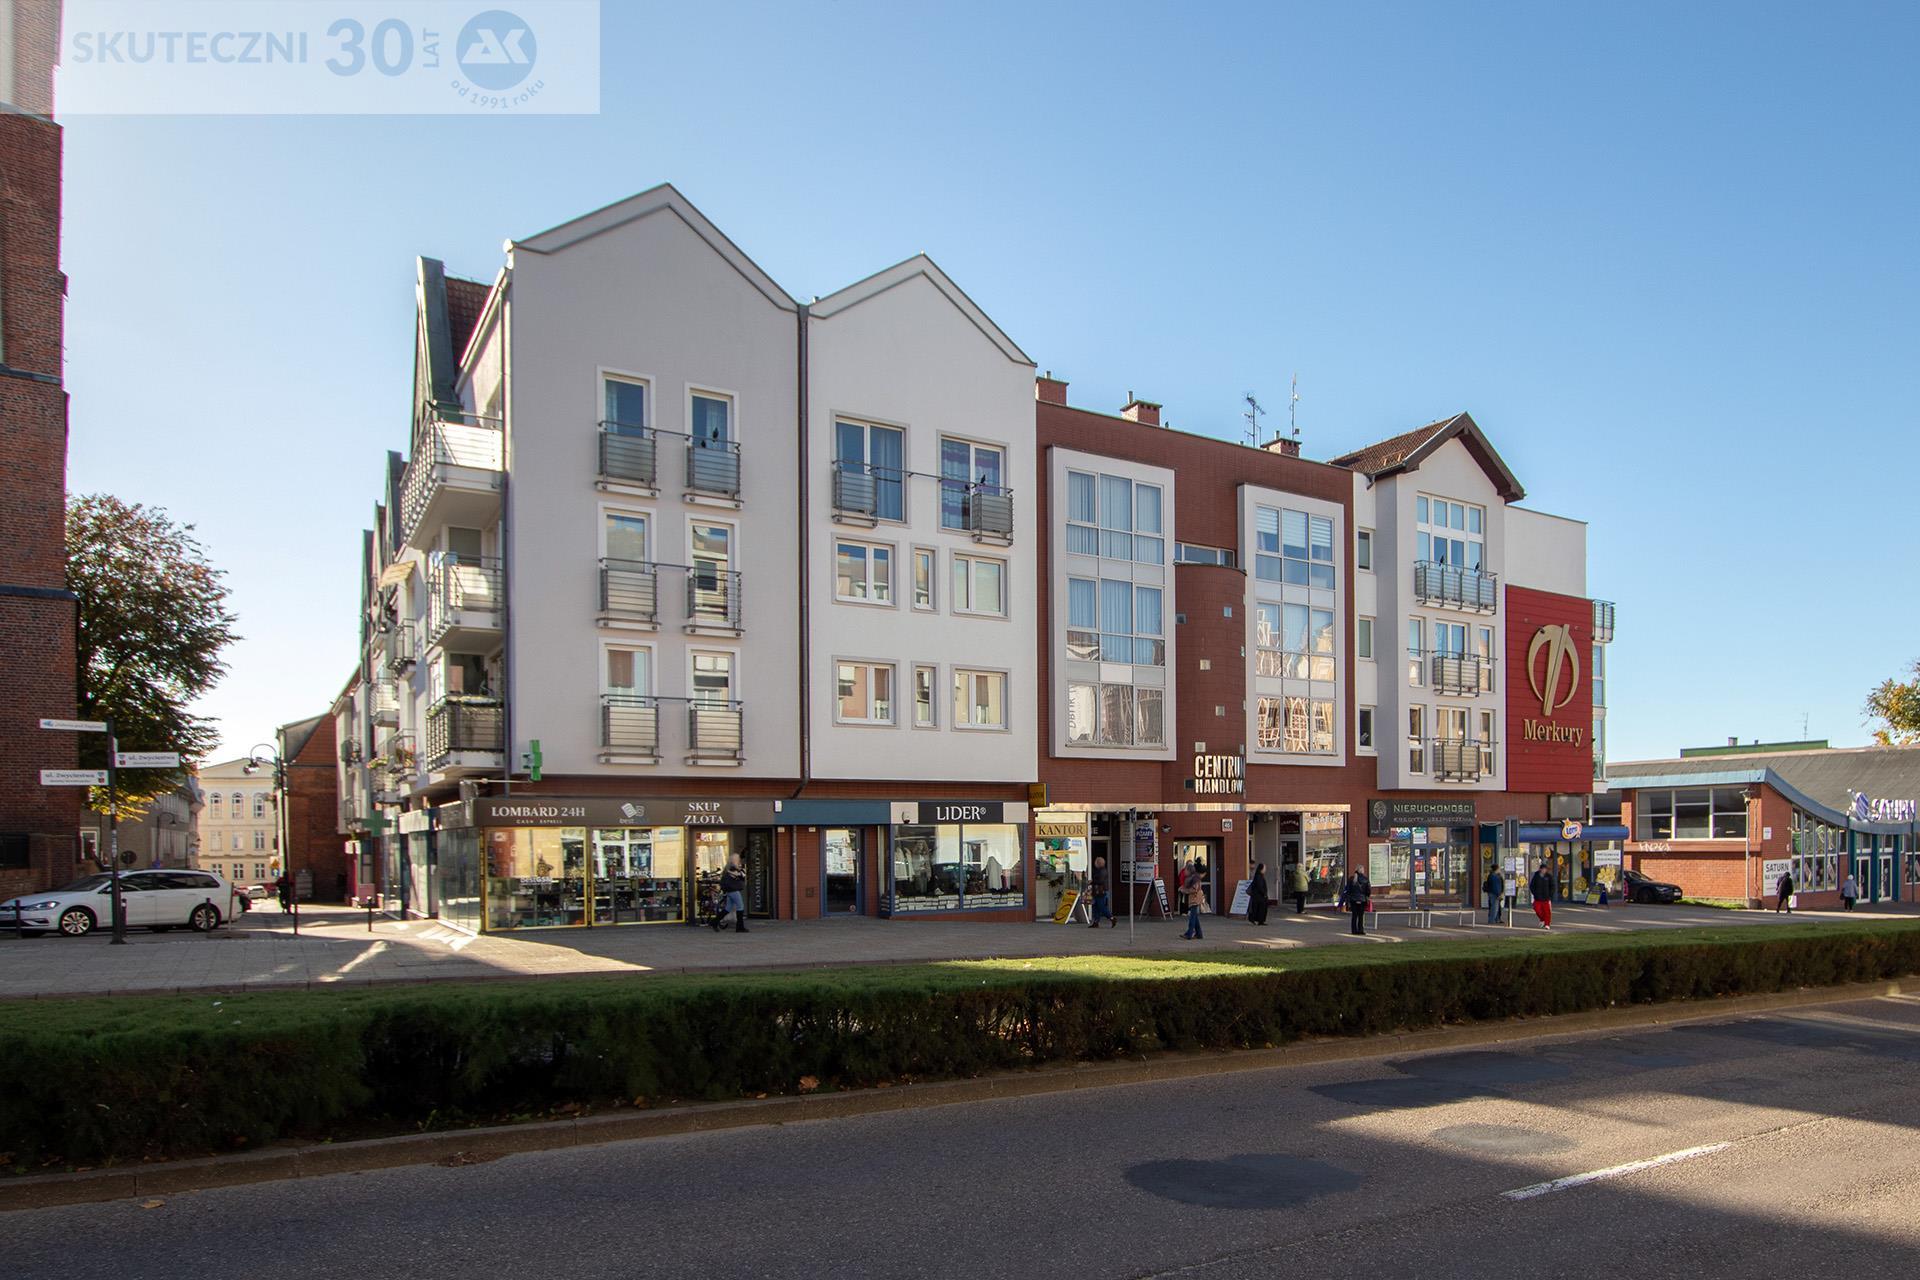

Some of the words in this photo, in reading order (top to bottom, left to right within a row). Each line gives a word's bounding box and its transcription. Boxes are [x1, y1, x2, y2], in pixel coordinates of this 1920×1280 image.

[1523, 718, 1584, 748] Merkury
[1195, 779, 1244, 794] HANDLOW
[688, 802, 720, 811] SKUP
[1393, 803, 1473, 813] NIERUCHOMOŚCI
[1871, 798, 1917, 821] SATURN
[492, 807, 558, 817] LOMBARD
[561, 807, 586, 817] 24H
[1038, 824, 1084, 835] KANTOR
[1766, 863, 1789, 872] SATURN
